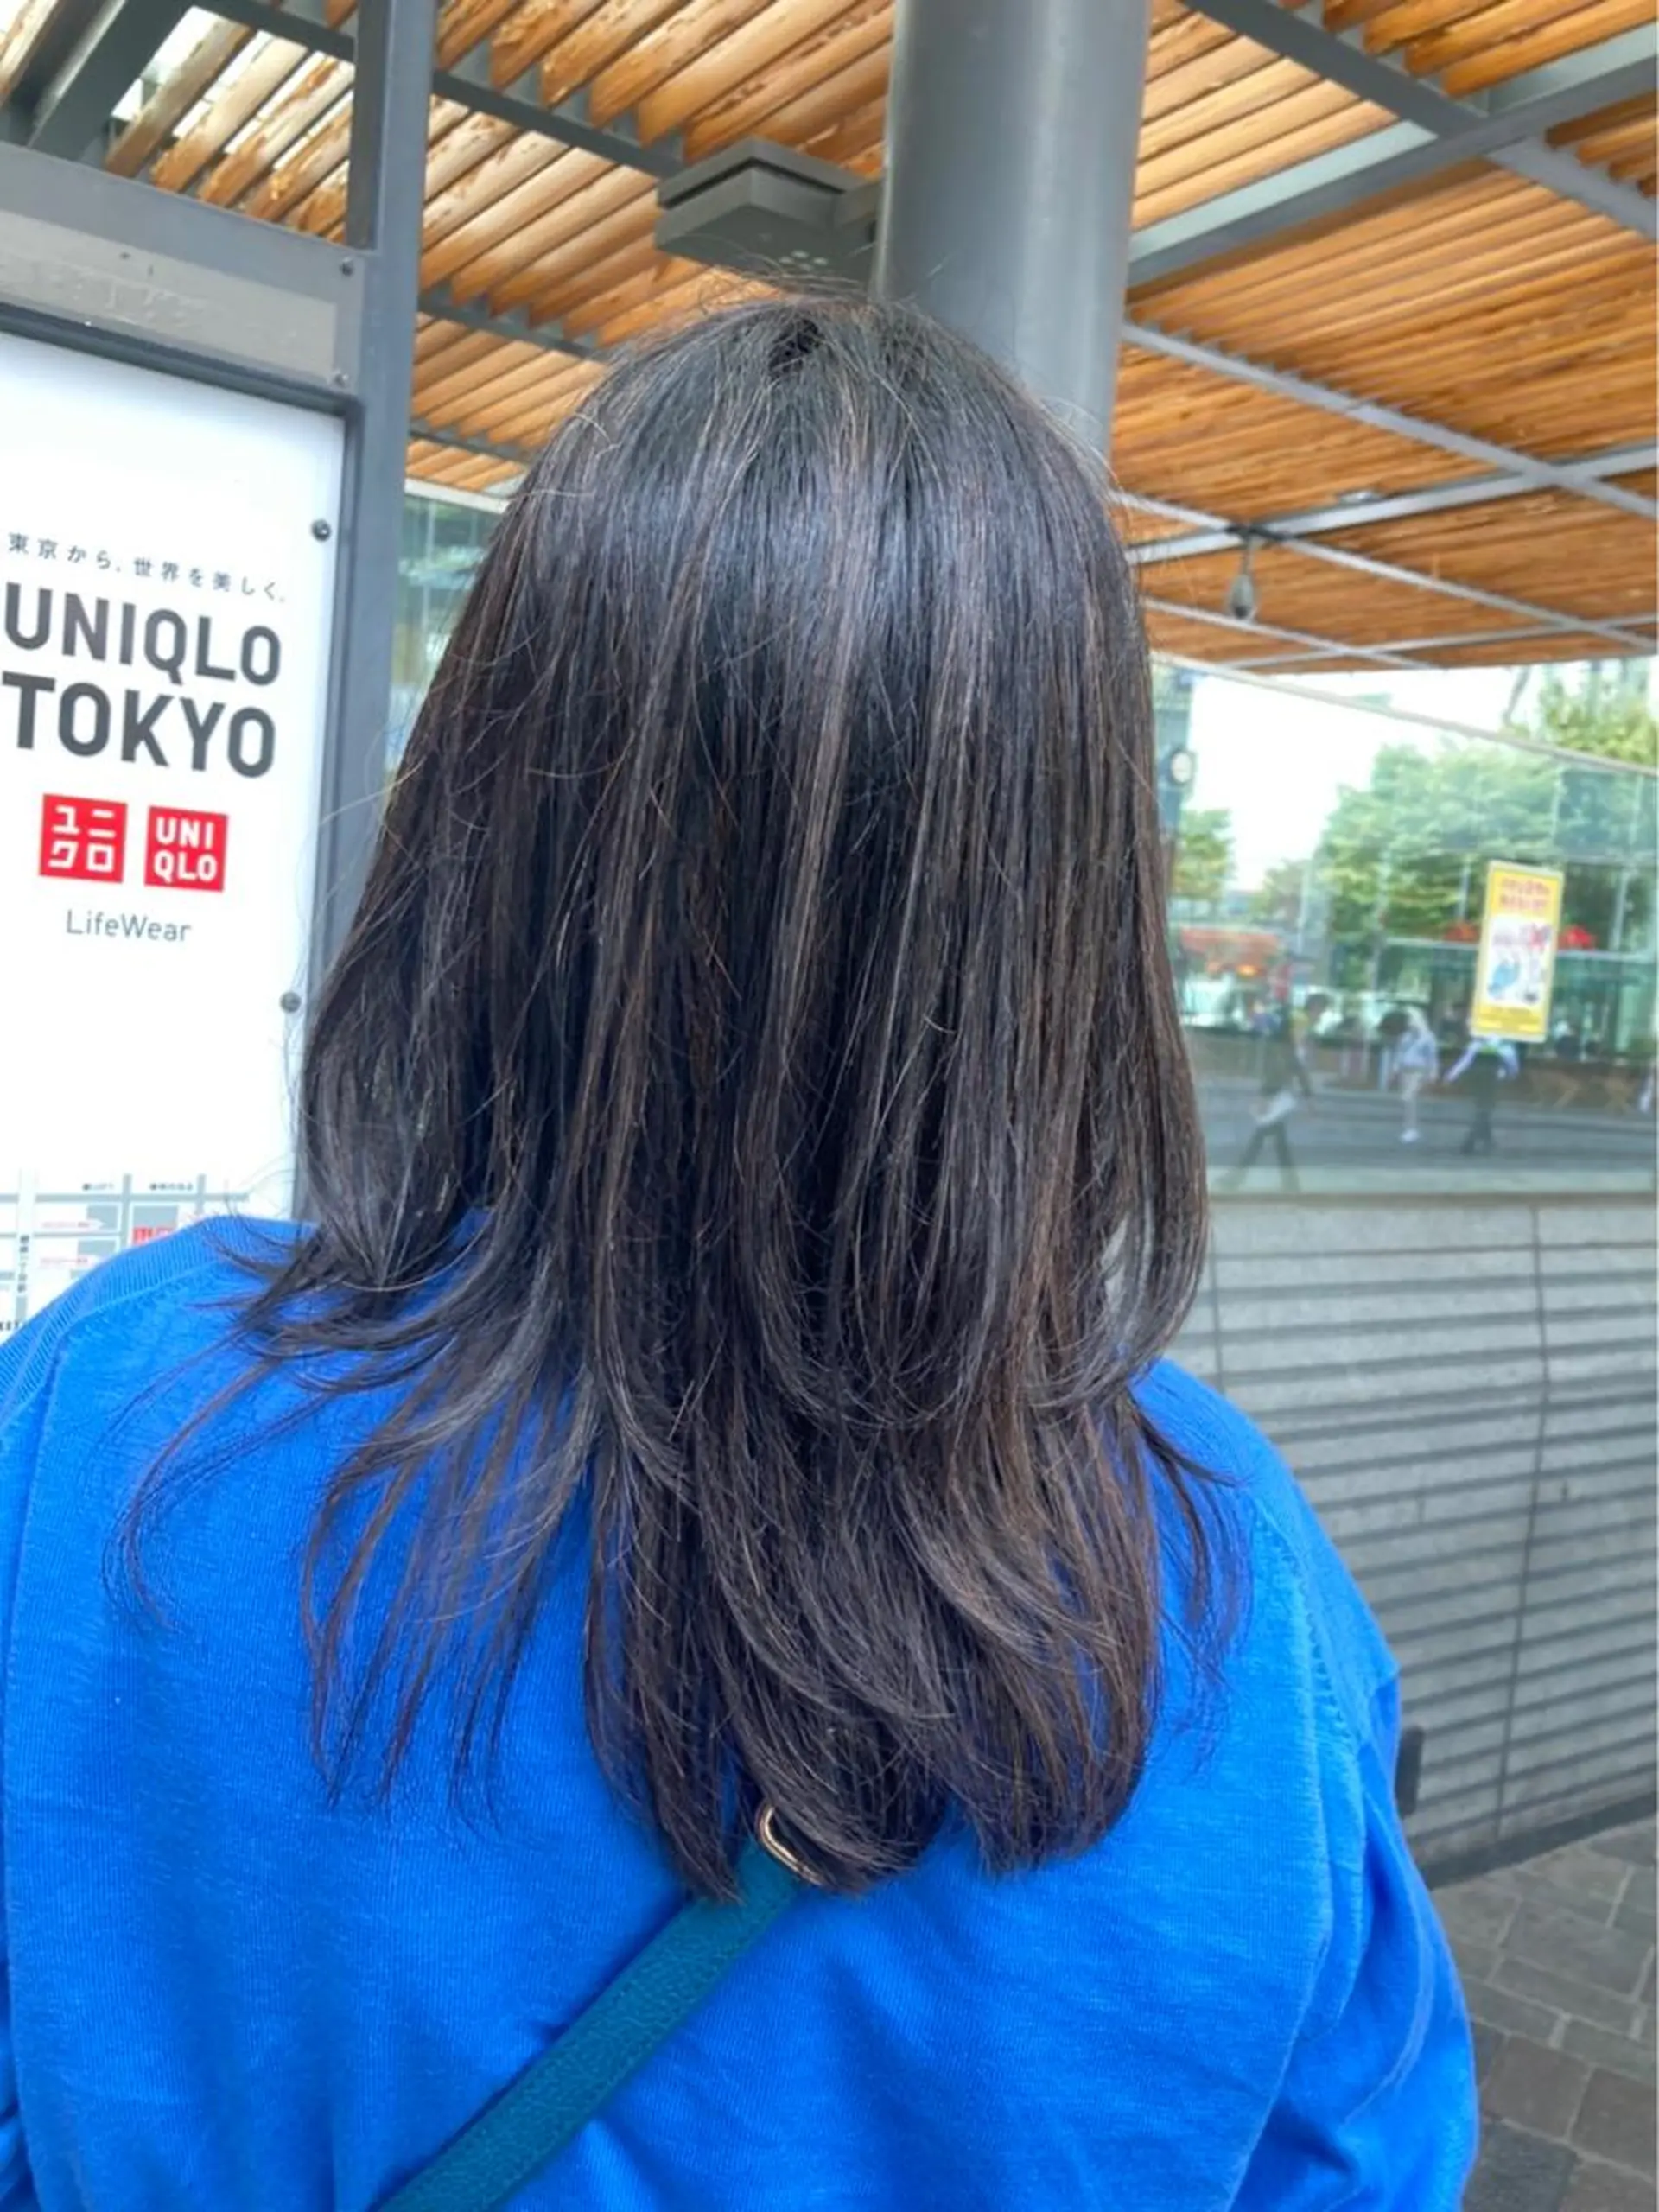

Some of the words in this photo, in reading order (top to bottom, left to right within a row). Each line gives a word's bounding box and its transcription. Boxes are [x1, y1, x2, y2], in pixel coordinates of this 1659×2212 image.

[3, 581, 282, 687] UNIQLO
[1, 669, 276, 779] TOKYO
[156, 816, 214, 849] UNI
[154, 849, 218, 882] QLO
[66, 910, 192, 942] LifeWear
